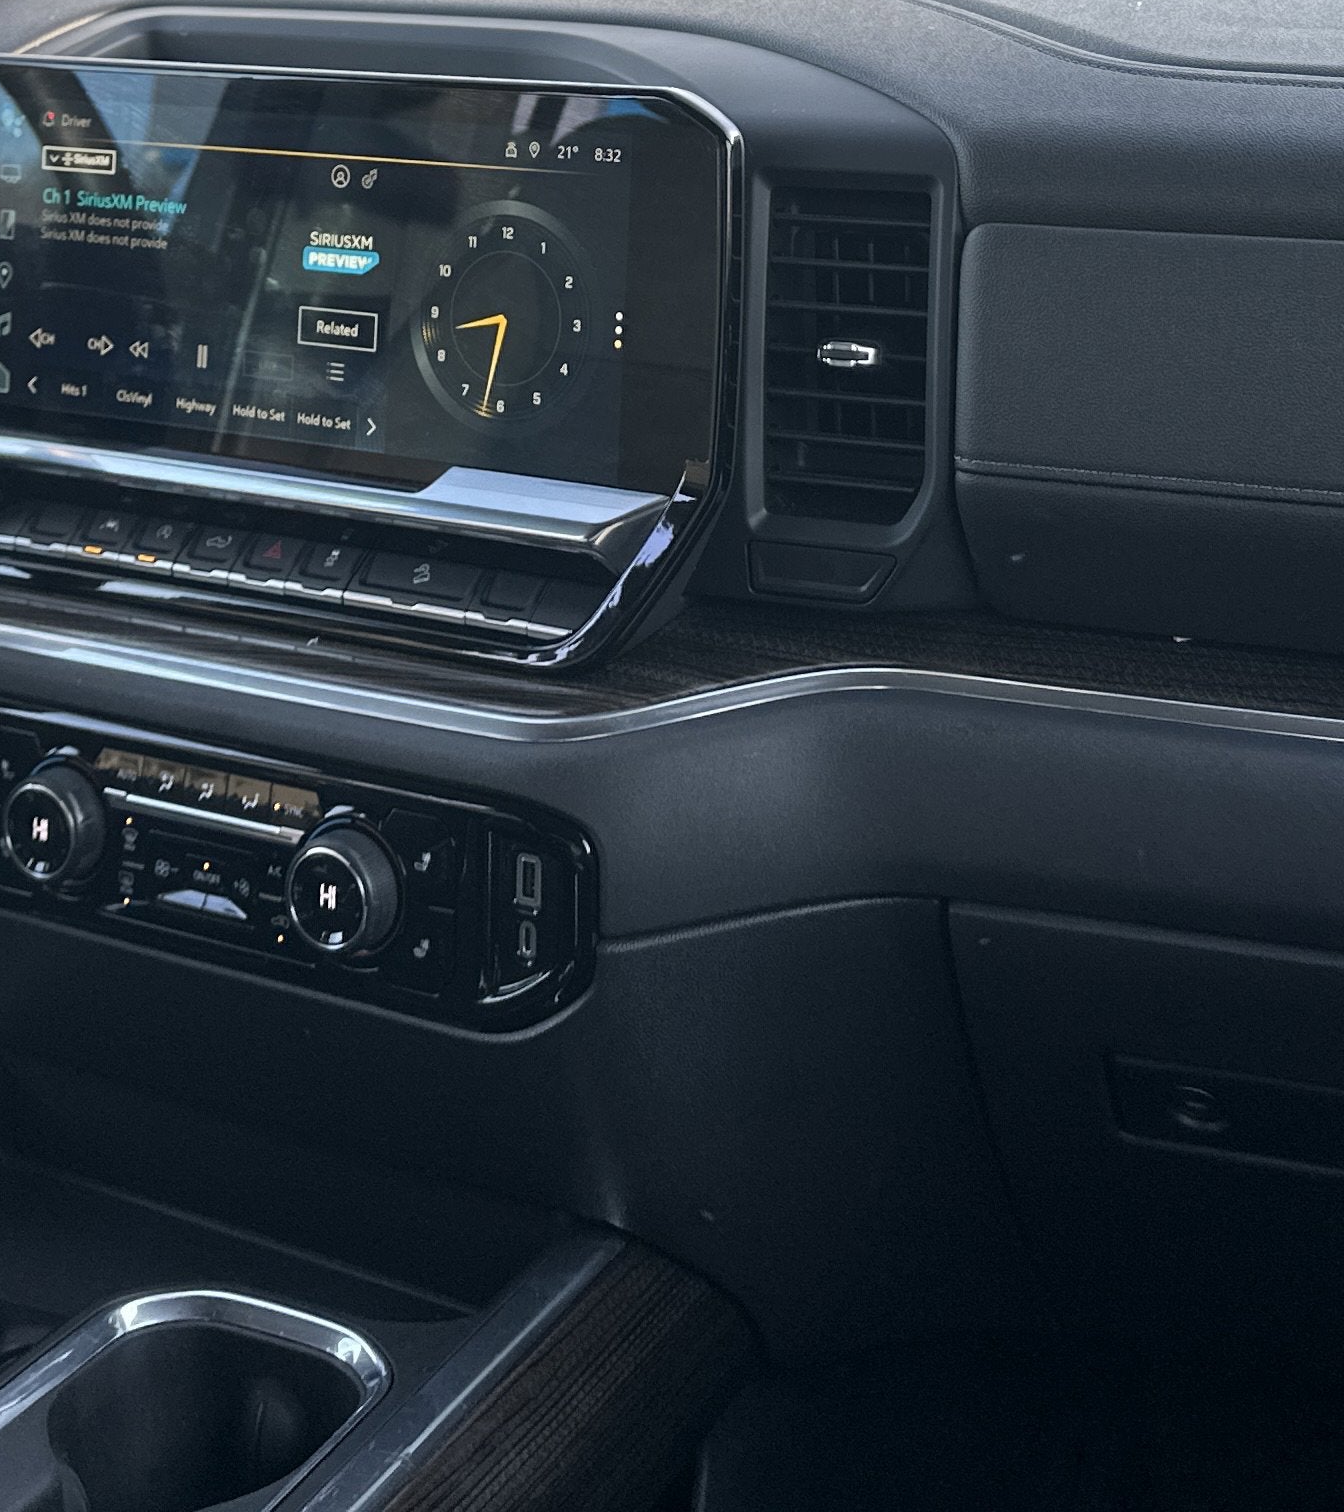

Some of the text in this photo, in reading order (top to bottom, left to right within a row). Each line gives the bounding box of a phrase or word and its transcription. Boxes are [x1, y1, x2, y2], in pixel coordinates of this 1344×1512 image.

[61, 114, 92, 128] Driver
[73, 153, 111, 166] SiriusXM
[557, 145, 622, 163] 21° 8:32
[43, 188, 187, 215] Ch 1 SiriusXM Preview
[41, 209, 170, 232] Sirius XM does not provide
[40, 226, 168, 250] Sirius XM does not provide
[501, 226, 514, 240] 12
[468, 235, 478, 248] 11
[540, 242, 546, 255] 1
[308, 251, 373, 269] PREVIEW
[439, 265, 452, 278] 10
[565, 276, 574, 289] 2
[431, 306, 439, 319] 9
[316, 320, 359, 338] Related
[573, 320, 581, 332] 3
[437, 350, 446, 362] 8
[559, 363, 569, 376] 4
[60, 383, 88, 397] Hits 1
[461, 384, 469, 397] 7
[116, 389, 153, 408] ClsVinyl
[533, 392, 541, 405] 5
[175, 398, 217, 416] Highway
[233, 404, 286, 423] Hold to Set
[496, 400, 505, 413] 6
[297, 412, 351, 430] Hold to Set
[32, 816, 49, 842] HI
[319, 882, 337, 910] HI
